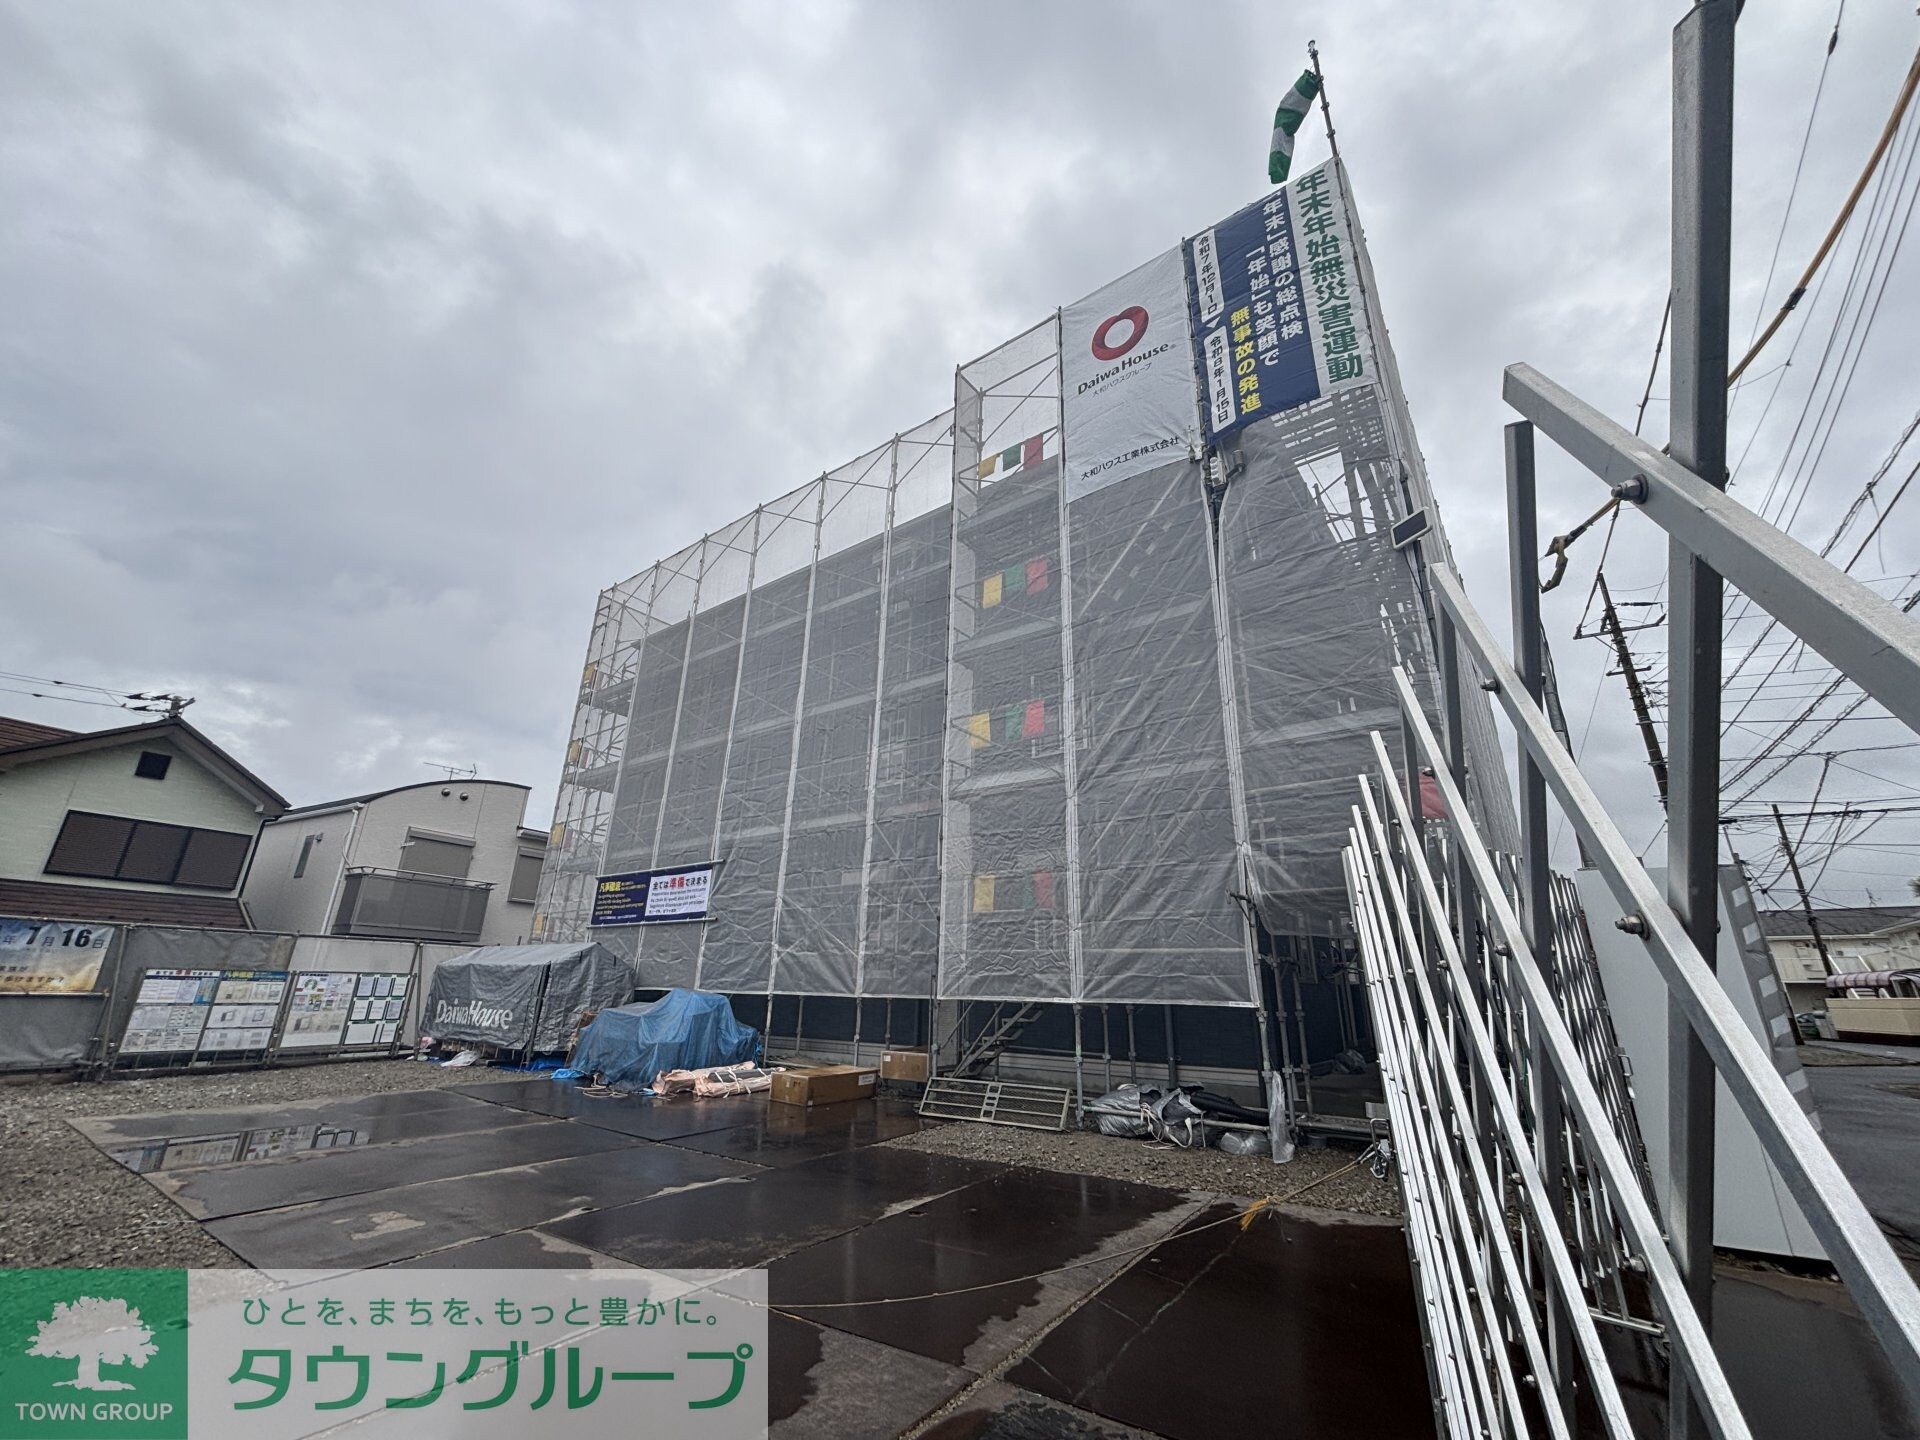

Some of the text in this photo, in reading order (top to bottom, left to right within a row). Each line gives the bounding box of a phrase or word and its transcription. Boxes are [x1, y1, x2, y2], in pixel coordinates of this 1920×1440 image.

[1246, 245, 1280, 366] 「年始」も笑顔で
[1262, 191, 1304, 339] 「年末」感謝の総点検
[1297, 169, 1363, 384] 年末年始無災害運動
[1077, 343, 1169, 395] Daiwa House
[1210, 336, 1229, 424] 令和8年1月15日
[1230, 306, 1262, 415] 無事故の発進
[1080, 436, 1180, 481] 大和ハウス工業株式会社
[0, 925, 104, 949] 年7月16日
